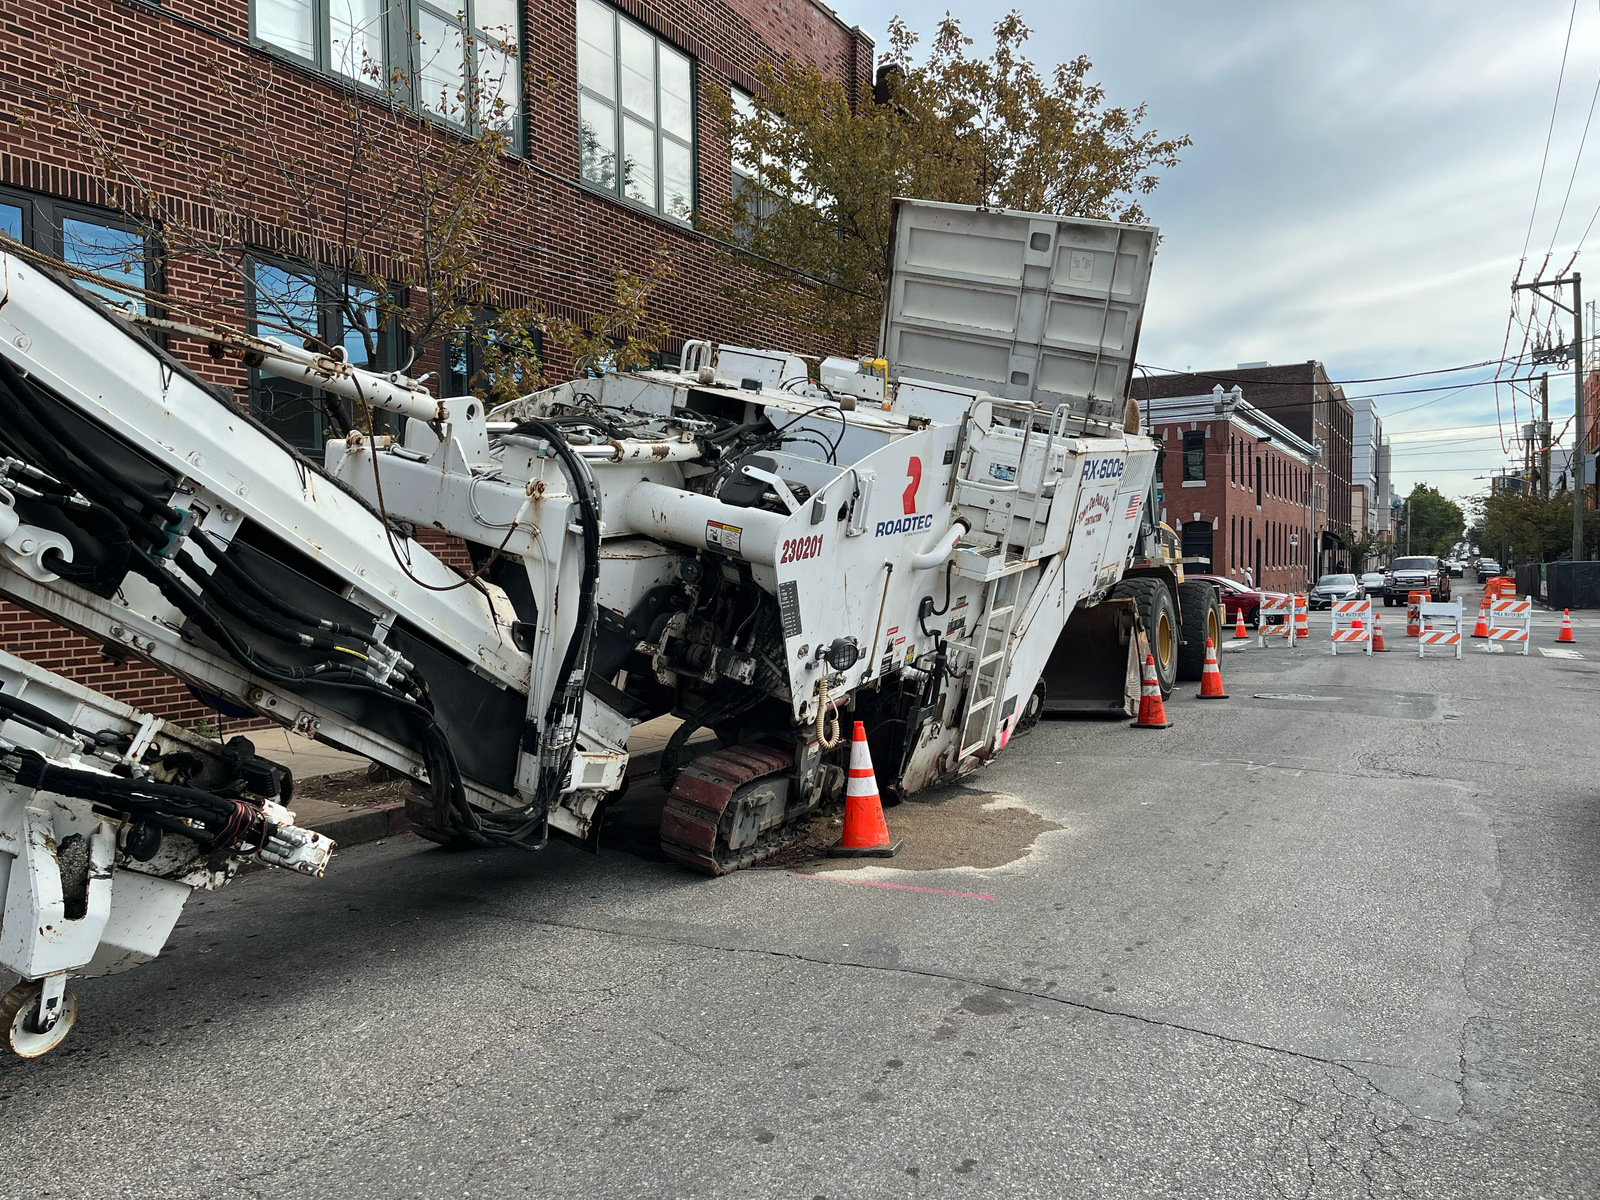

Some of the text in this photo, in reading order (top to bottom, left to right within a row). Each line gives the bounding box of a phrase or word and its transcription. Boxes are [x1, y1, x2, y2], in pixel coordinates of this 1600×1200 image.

[1082, 458, 1124, 480] RX-600e
[875, 514, 933, 537] ROADTEC
[780, 534, 824, 564] 230201
